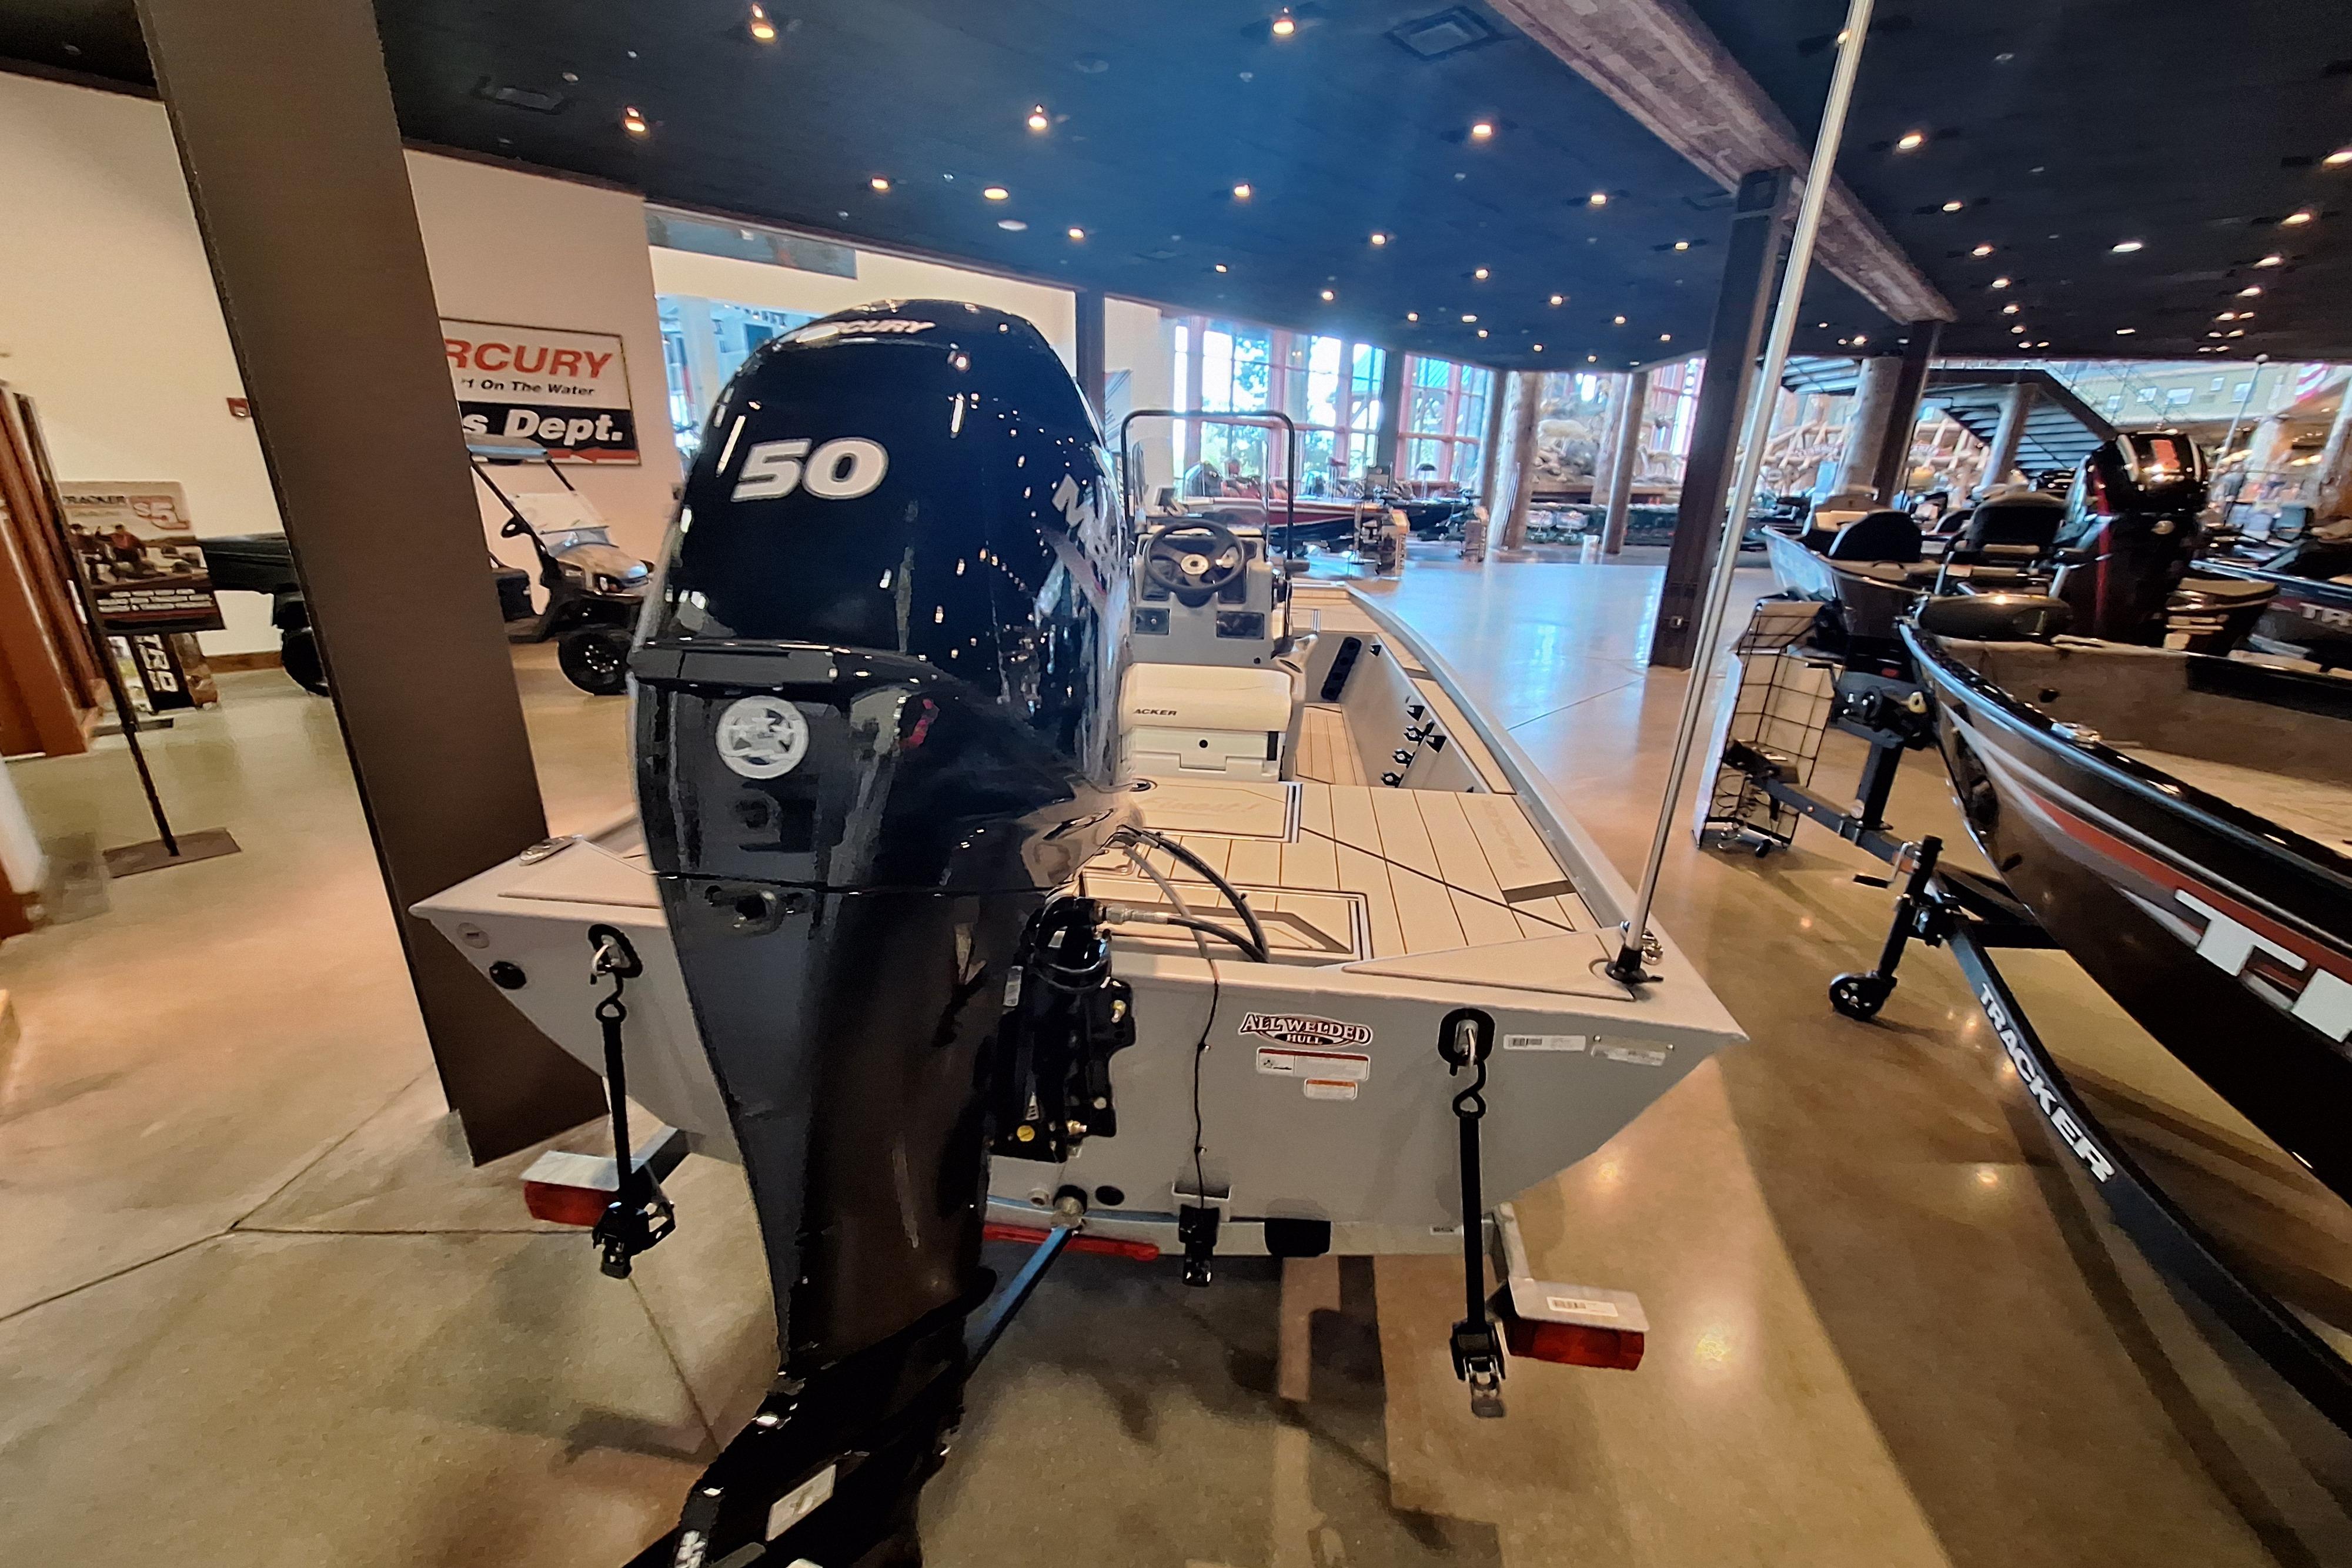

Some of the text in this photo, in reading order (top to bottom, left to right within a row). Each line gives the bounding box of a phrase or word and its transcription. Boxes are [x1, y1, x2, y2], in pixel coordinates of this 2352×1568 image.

[481, 380, 504, 390] On
[512, 381, 542, 393] The
[548, 384, 596, 396] Water
[503, 409, 624, 446] Dept.
[731, 438, 889, 502] 50
[1242, 1014, 1370, 1044] ALL WELDED
[1287, 1034, 1323, 1045] HULL
[1980, 982, 2115, 1184] TRACKER
